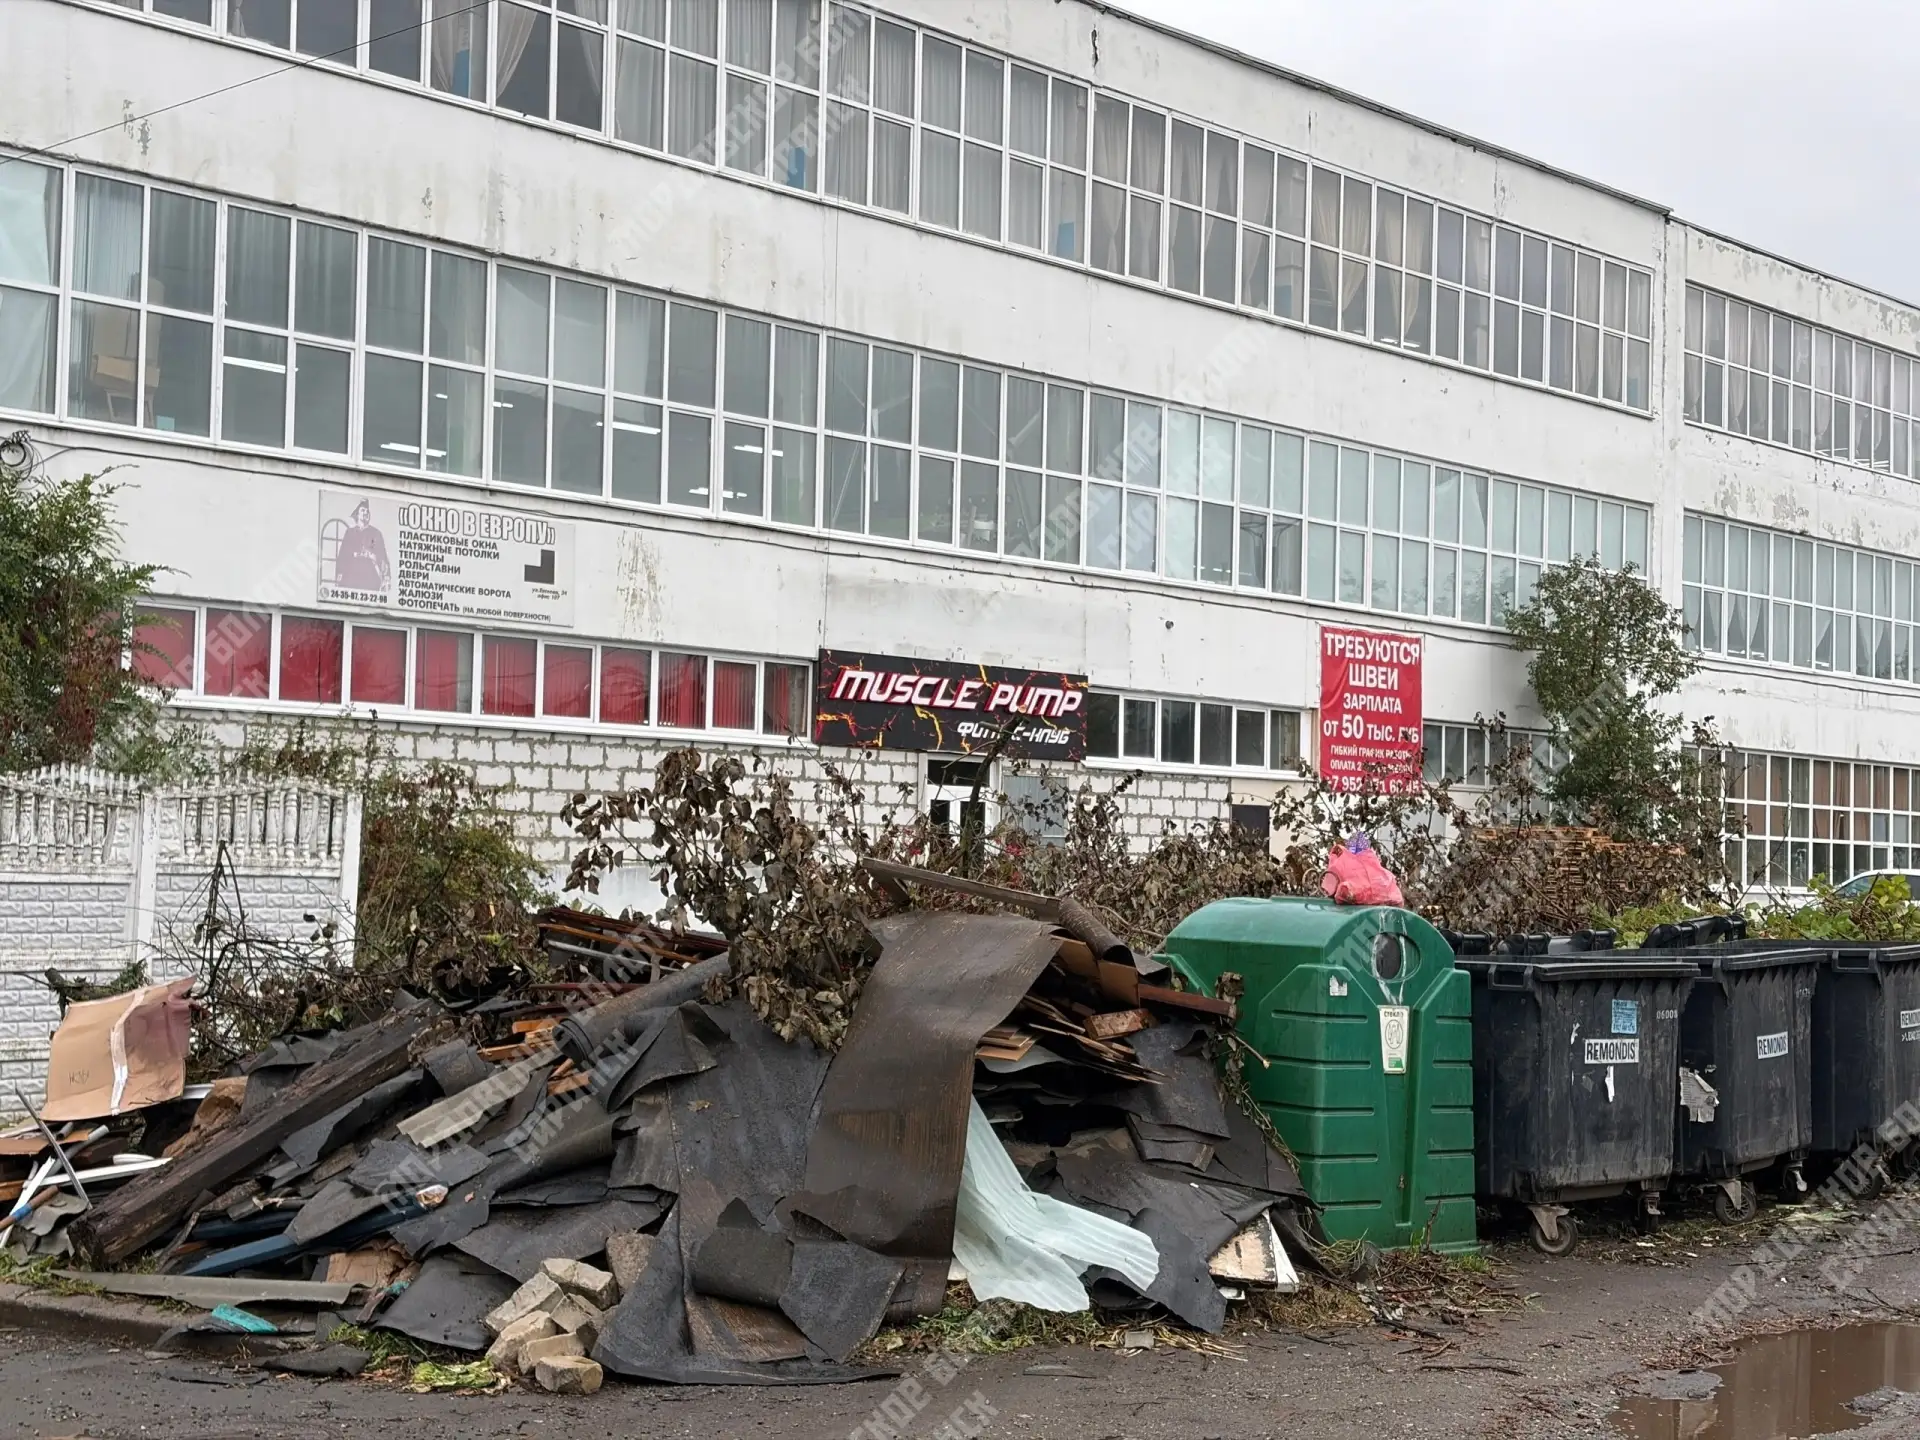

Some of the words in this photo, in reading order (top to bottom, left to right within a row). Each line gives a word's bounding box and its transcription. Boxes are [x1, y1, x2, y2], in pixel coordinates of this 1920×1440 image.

[399, 503, 460, 534] «ОКНО
[463, 510, 477, 536] В
[480, 513, 556, 546] ЕВРОПУ»
[400, 531, 469, 547] ПЛАСТИКОВЫЕ
[472, 540, 498, 550] ОКНА
[399, 550, 444, 563] ТЕПЛИЦЫ
[400, 541, 452, 554] НАТЯЖНЫЕ
[456, 547, 500, 560] ПОТОЛКИ
[399, 560, 461, 574] РОЛЬСТАВНИ
[399, 570, 429, 580] ДВЕРИ
[399, 580, 476, 595] АВТОМАТИЧЕСКИЕ
[478, 588, 511, 598] ВОРОТА
[399, 588, 443, 600] ЖАЛЮЗИ
[398, 598, 460, 612] ФОТОПЕЧАТЬ
[476, 607, 501, 616] ЛЮБОЙ
[504, 611, 551, 622] ПОВЕРХНОСТИ)
[1324, 633, 1419, 665] ТРЕБУЮТСЯ
[1348, 663, 1399, 690] ШВЕИ
[831, 669, 983, 710] MUSCLE
[987, 684, 1083, 718] PUMP
[1343, 692, 1402, 714] ЗАРПЛАТА
[1323, 719, 1339, 737] ОТ
[1341, 713, 1364, 739] 50
[1366, 724, 1396, 741] ТЫС.
[1330, 744, 1358, 757] ГИБКИЙ
[1330, 759, 1356, 770] ОПЛАТА
[1586, 1042, 1636, 1061] REMONDIS
